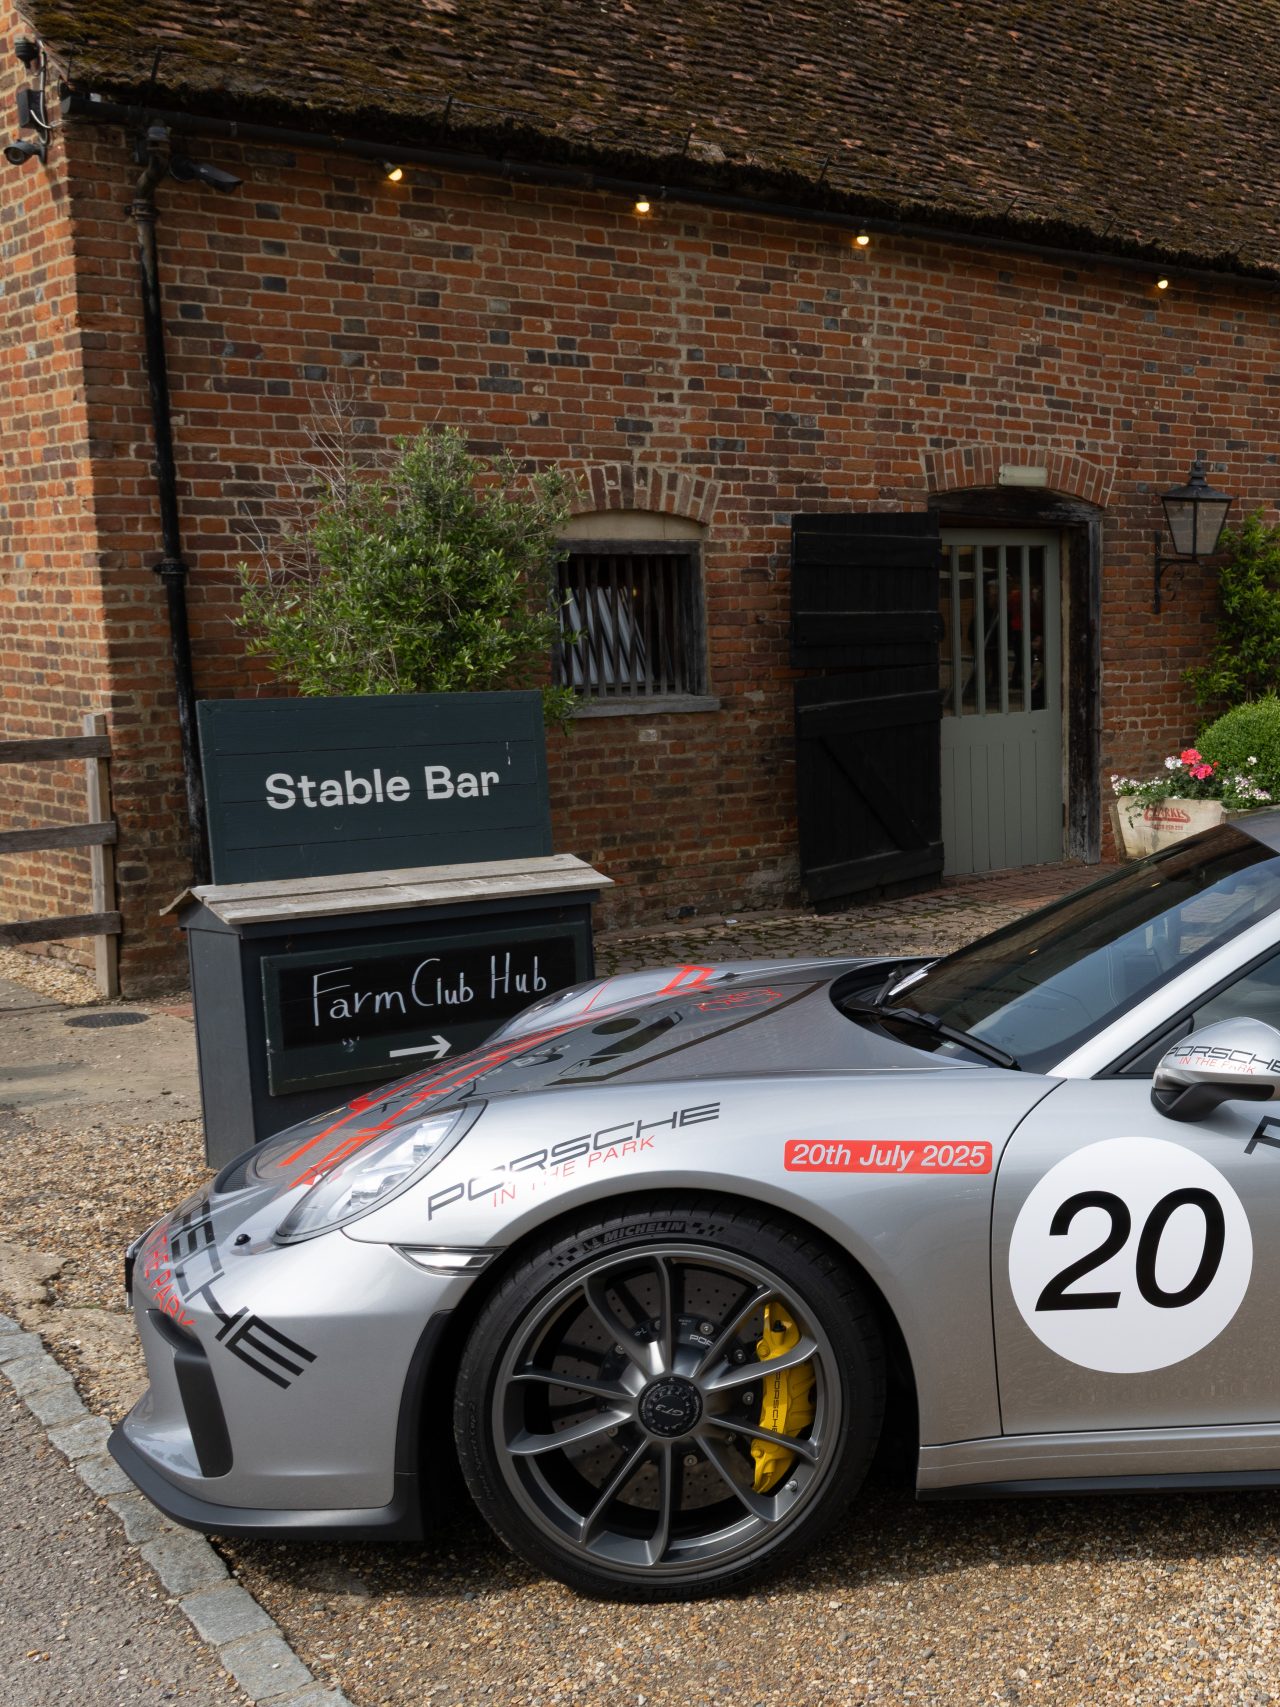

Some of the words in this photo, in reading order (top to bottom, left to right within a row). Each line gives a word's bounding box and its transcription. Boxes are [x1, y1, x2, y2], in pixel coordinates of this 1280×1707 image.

[265, 768, 411, 810] Stable
[424, 765, 500, 800] Bar
[312, 967, 407, 1027] Farm
[411, 958, 474, 1007] Club
[490, 952, 547, 999] Hub
[1179, 1057, 1191, 1065] IN
[428, 1102, 720, 1221] PORSCHE
[492, 1184, 517, 1208] IN
[587, 1135, 656, 1168] PARK
[791, 1143, 852, 1166] 20th
[859, 1144, 915, 1172] July
[920, 1145, 986, 1168] 2025
[603, 1220, 687, 1245] MICHELIN
[1035, 1187, 1226, 1312] 20
[655, 1404, 684, 1416] GT3
